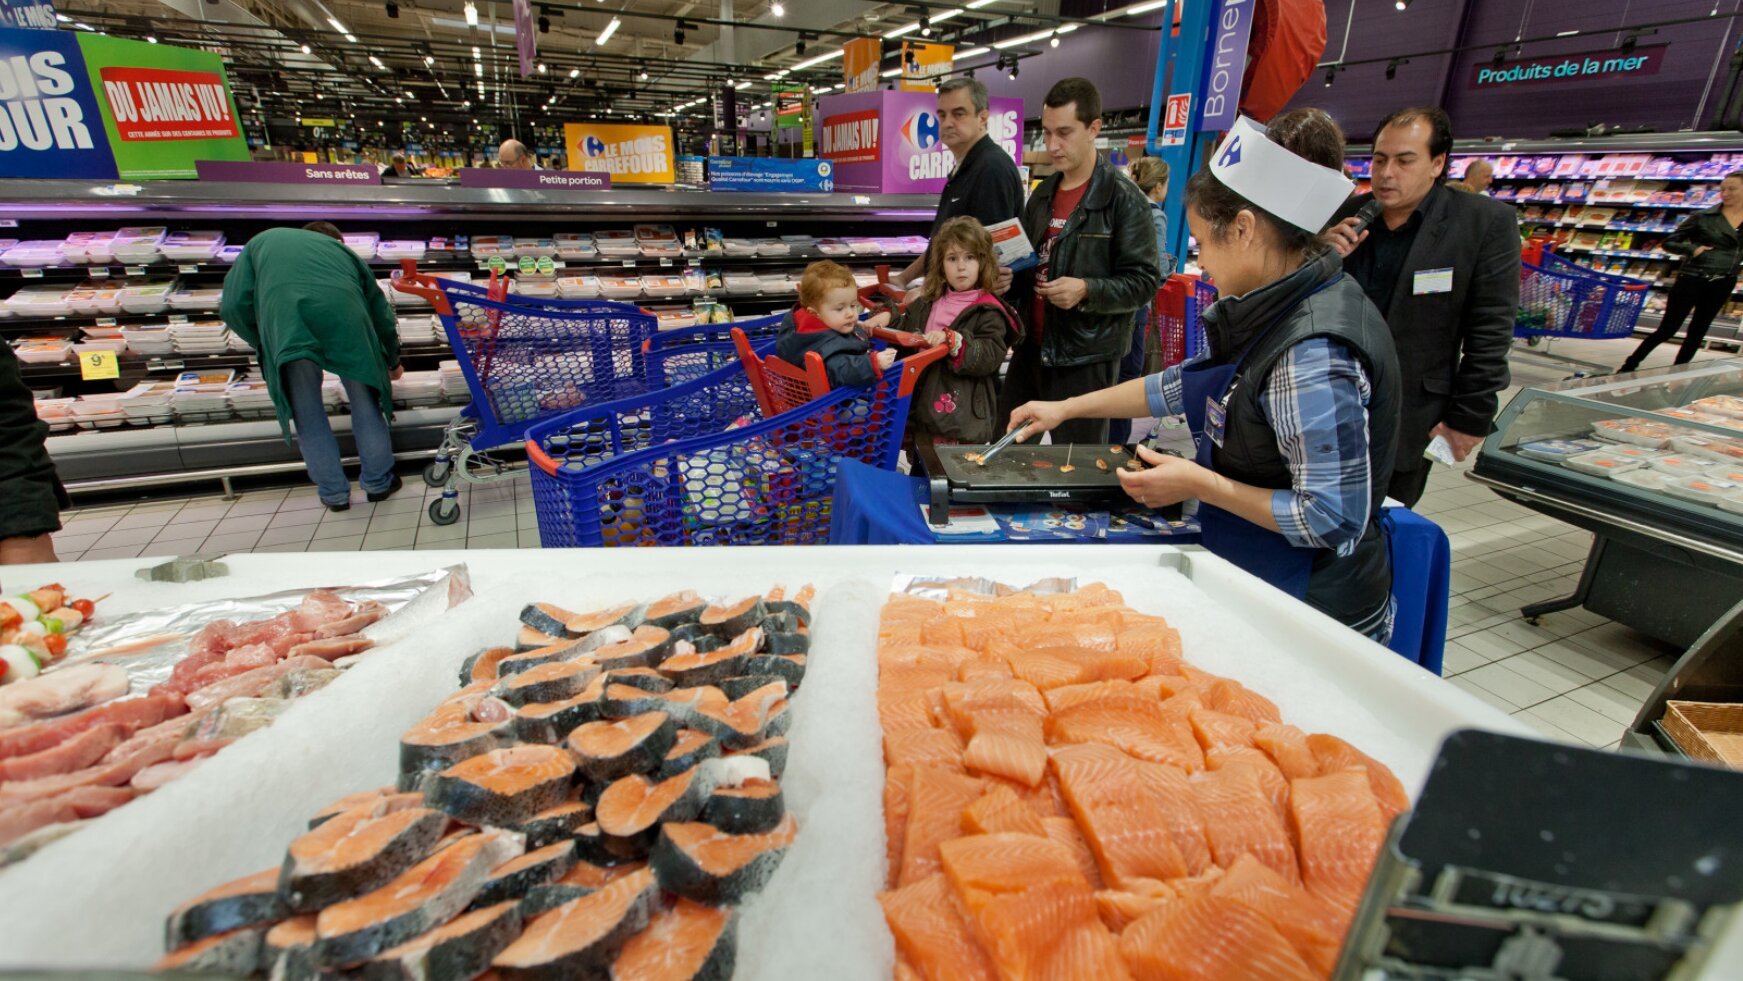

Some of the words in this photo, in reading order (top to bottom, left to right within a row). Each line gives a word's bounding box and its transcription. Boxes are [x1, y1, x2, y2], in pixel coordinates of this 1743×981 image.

[1478, 63, 1552, 84] Produits
[1553, 60, 1579, 77] de
[1581, 58, 1600, 75] la
[1602, 56, 1648, 73] mer
[104, 81, 138, 122] DU
[136, 82, 202, 122] JAMAIS
[604, 144, 618, 157] LE
[620, 135, 666, 156] MOIS
[823, 126, 832, 153] DU
[833, 120, 859, 152] JAMAIS
[306, 169, 333, 178] Sans
[334, 169, 369, 179] arêtes
[585, 152, 668, 174] CARREFOUR
[540, 176, 567, 184] Petite
[569, 176, 602, 187] portion
